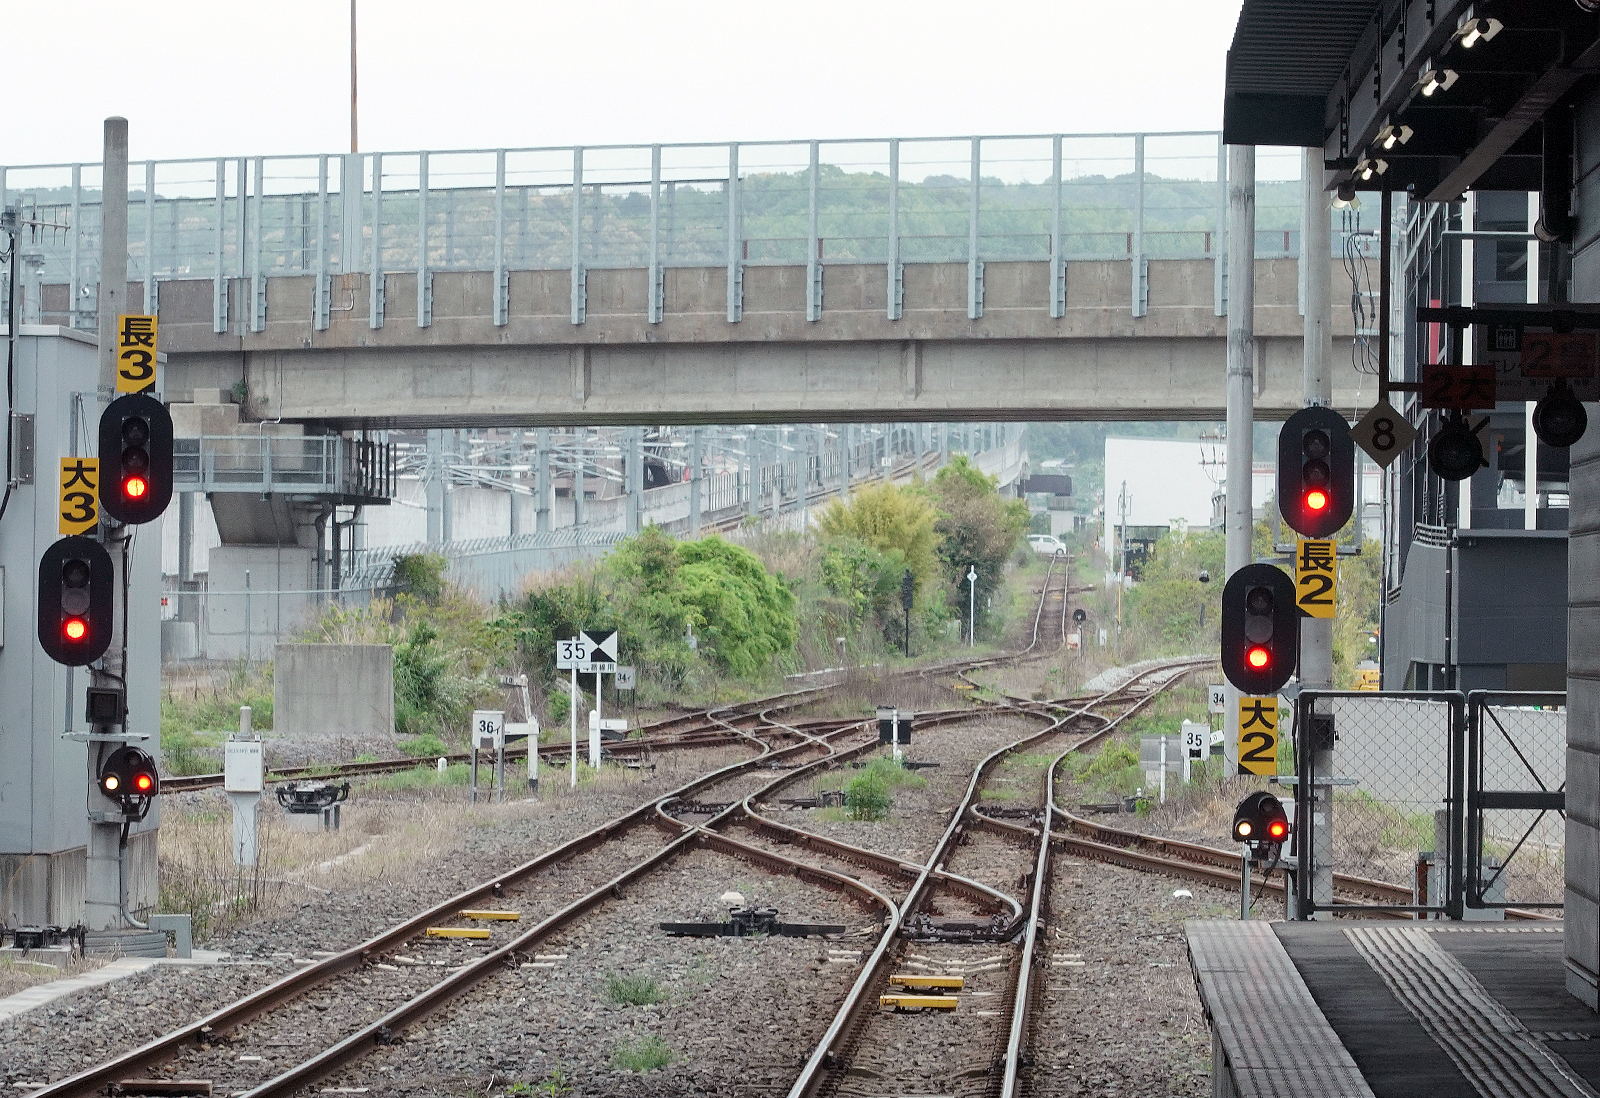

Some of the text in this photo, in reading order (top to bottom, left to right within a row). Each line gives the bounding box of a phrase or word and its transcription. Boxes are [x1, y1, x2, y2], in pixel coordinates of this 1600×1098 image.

[119, 317, 155, 380] 長3
[1430, 371, 1491, 402] 2大
[1372, 417, 1396, 451] 8
[61, 461, 97, 523] 大3
[1299, 541, 1334, 604] 長2
[562, 642, 585, 660] 35
[1186, 732, 1203, 747] 35
[1241, 699, 1275, 763] 大2
